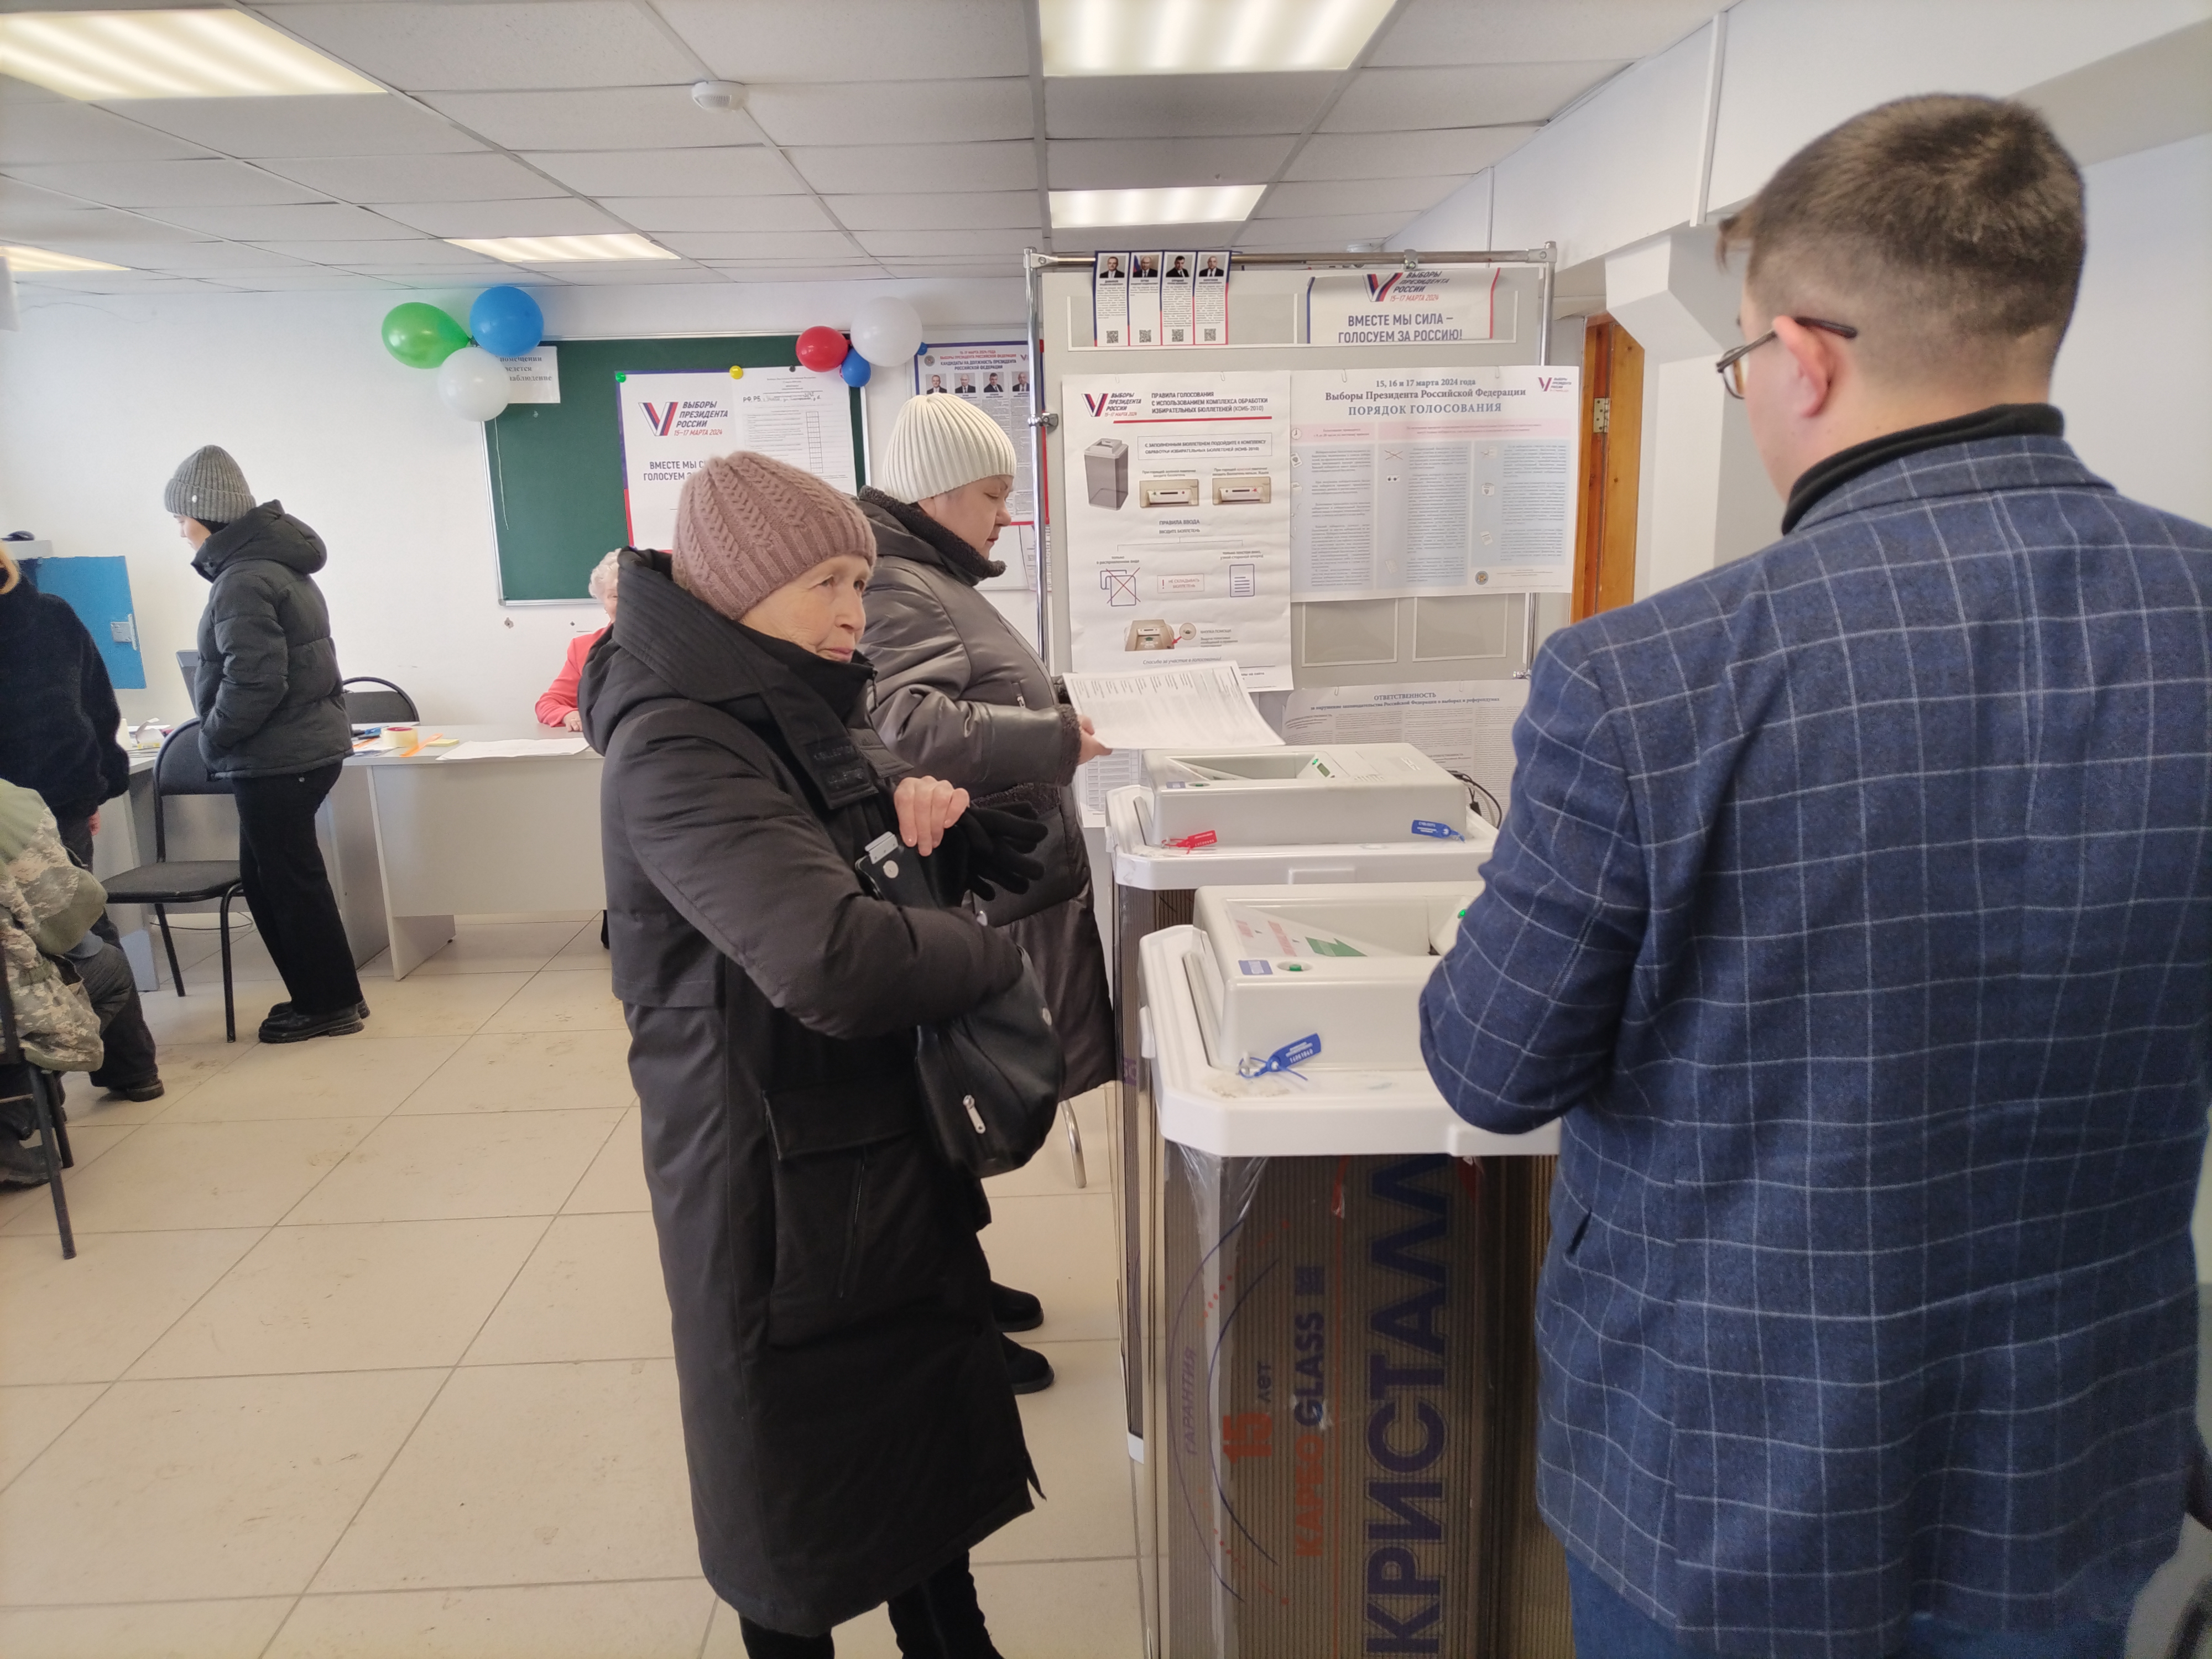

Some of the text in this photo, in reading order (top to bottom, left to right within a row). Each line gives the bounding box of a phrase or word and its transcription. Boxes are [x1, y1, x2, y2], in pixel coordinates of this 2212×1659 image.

[1348, 315, 1390, 326] ВМЕСТЕ
[1393, 314, 1411, 325] МЫ
[1415, 313, 1443, 325] СИЛА
[1338, 329, 1462, 343] ГОЛОСУЕМ ЗА РОССИЮ!
[1325, 388, 1526, 402] Выборы Президента Российской Федерации
[679, 410, 728, 419] ПРЕЗИДЕНТА
[1349, 403, 1501, 416] ПОРЯДОК ГОЛОСОВАНИЯ
[650, 461, 680, 469] ВМЕСТЕ
[682, 461, 697, 469] МЫ
[644, 472, 685, 481] ГОЛОСУЕМ
[1374, 692, 1437, 701] ОТВЕТСТВЕННОСТЬ
[1181, 1346, 1197, 1456] ГАРАНТИЯ
[1365, 1155, 1454, 1655] КРИСТАЛЛ
[1222, 1411, 1273, 1463] 15
